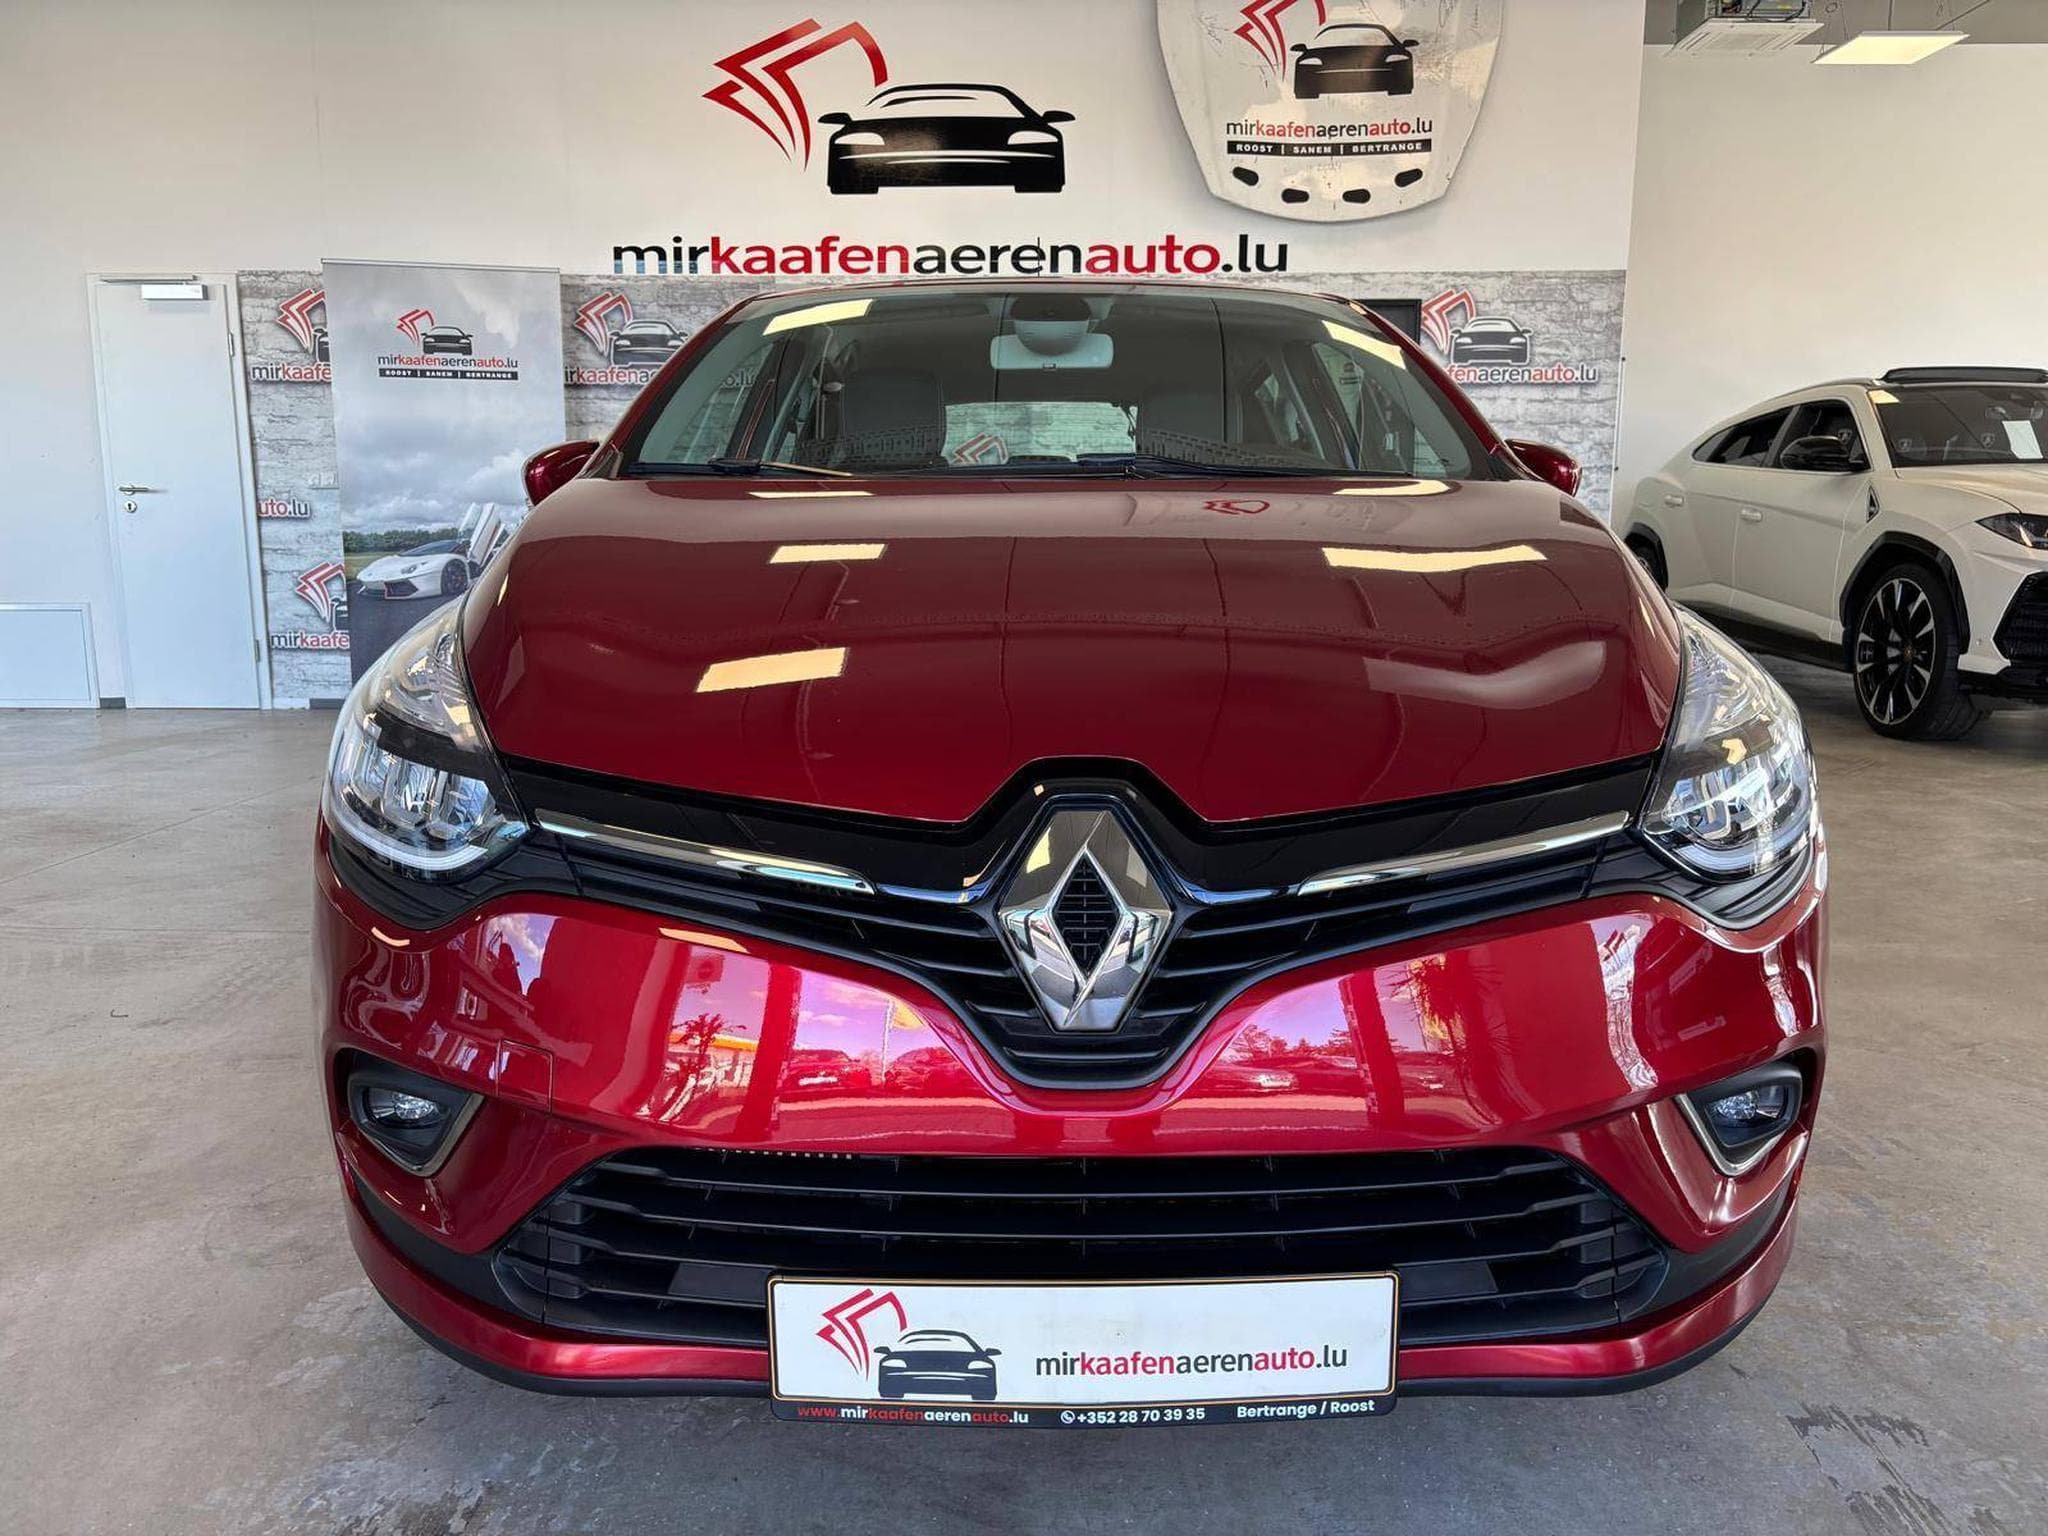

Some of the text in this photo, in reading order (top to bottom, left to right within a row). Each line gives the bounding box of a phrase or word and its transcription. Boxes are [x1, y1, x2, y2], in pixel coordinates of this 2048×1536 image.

[1226, 117, 1433, 138] mirkaafenaerenauto.lu
[1236, 142, 1422, 154] ROOST SANEM BERTRANGE
[613, 234, 1289, 274] mirkaafenaerenauto.lu
[377, 353, 518, 368] mirkaafenaerenauto.lu
[252, 363, 331, 380] mirkaafe
[257, 499, 309, 516] uto.lu
[271, 631, 349, 648] mirkaafe
[1036, 1344, 1347, 1376] mirkaafenaerenauto.lu
[797, 1405, 1029, 1423] www.mirkaafenaerenauto.lu
[1077, 1410, 1116, 1424] +352
[1119, 1410, 1138, 1423] 28
[1141, 1409, 1160, 1422] 70
[1163, 1408, 1182, 1421] 39
[1186, 1407, 1205, 1420] 35
[1237, 1404, 1317, 1419] Bertrange
[1330, 1399, 1375, 1413] Roost
